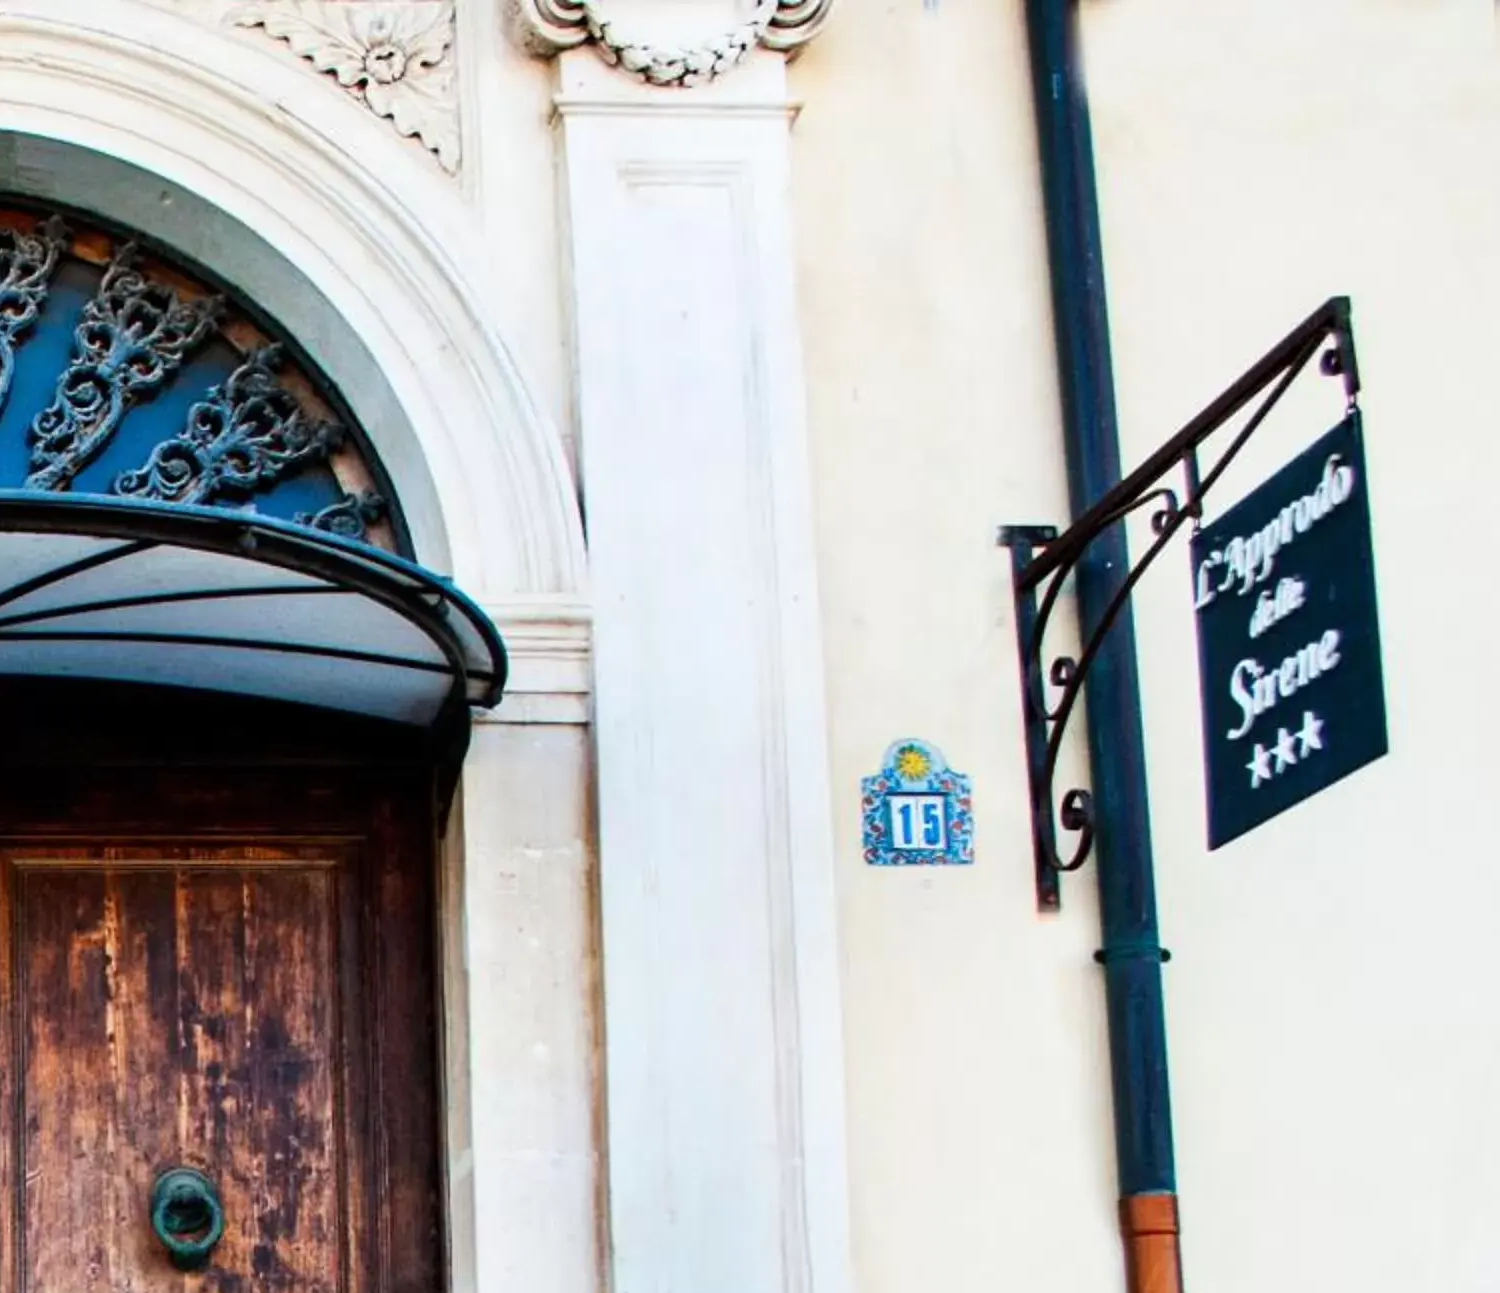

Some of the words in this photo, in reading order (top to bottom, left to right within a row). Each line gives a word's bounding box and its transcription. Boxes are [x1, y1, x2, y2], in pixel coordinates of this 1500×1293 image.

[1195, 453, 1354, 609] L'Approdo
[1226, 629, 1342, 740] Sirene
[898, 803, 941, 846] 15
